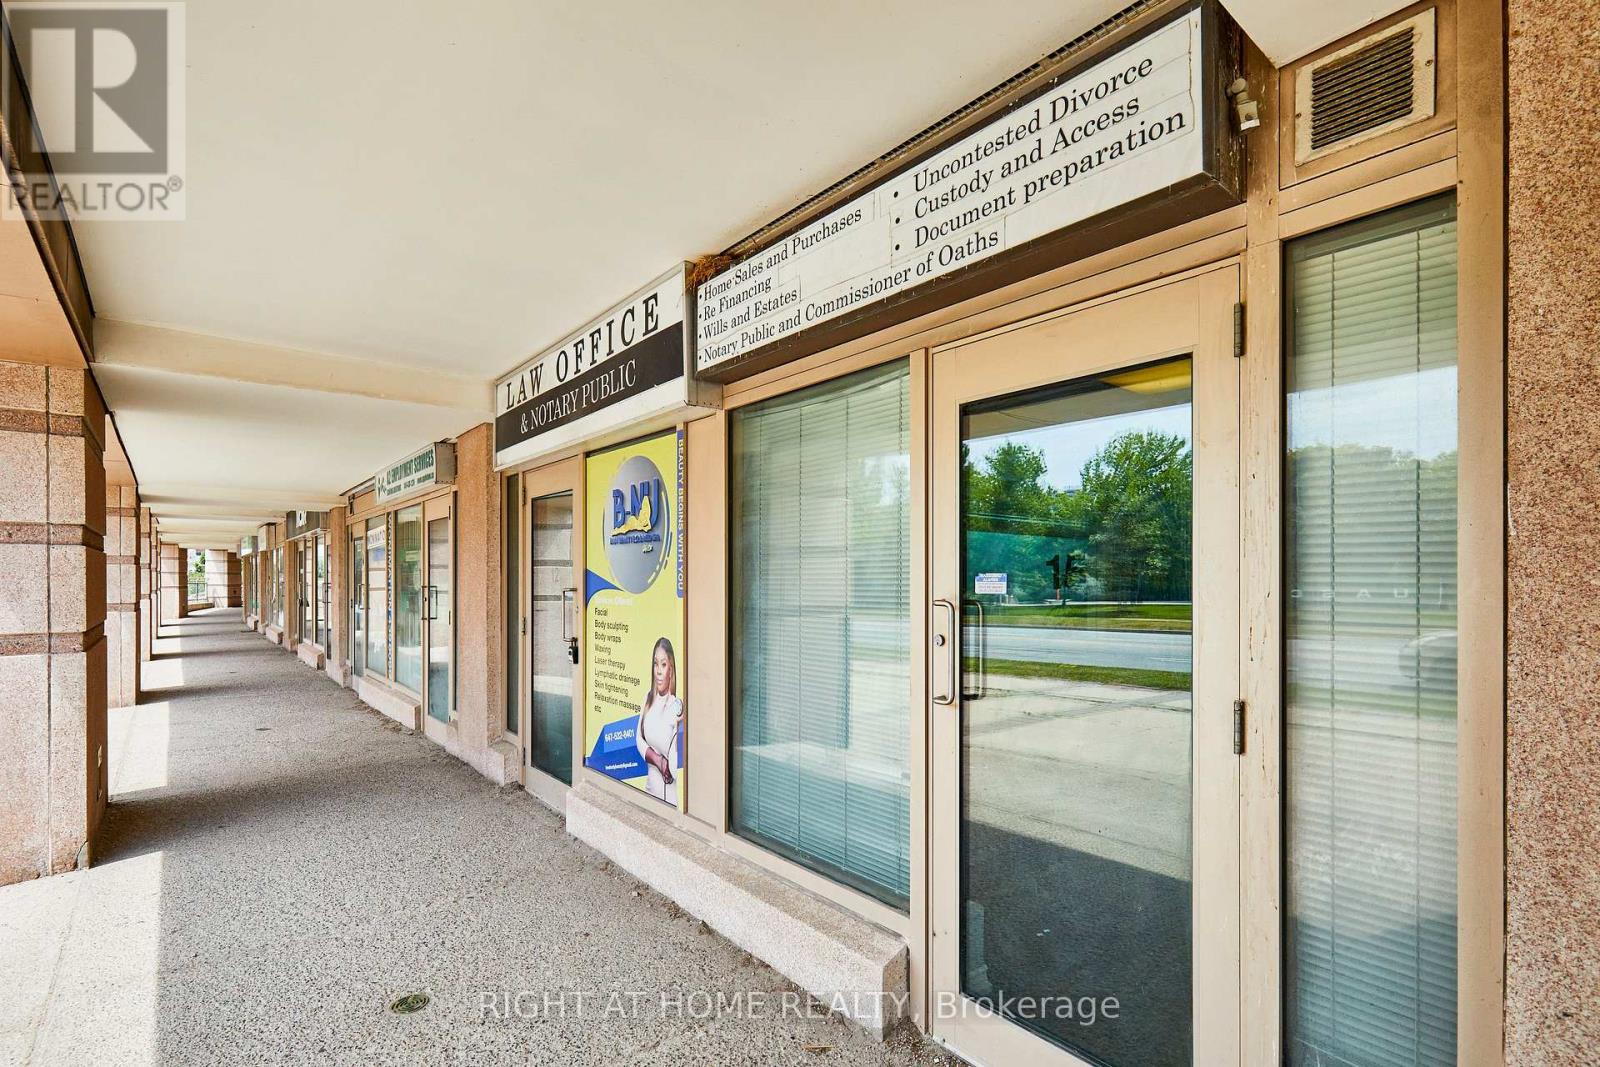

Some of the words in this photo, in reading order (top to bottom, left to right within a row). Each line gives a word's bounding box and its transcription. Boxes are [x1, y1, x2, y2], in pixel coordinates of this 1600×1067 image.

[913, 108, 1041, 193] Uncontested
[1049, 58, 1153, 125] Divorce
[914, 171, 994, 219] Custody
[1000, 143, 1044, 179] and
[1050, 97, 1140, 154] Access
[914, 187, 1016, 249] Document
[1023, 111, 1186, 205] preparation
[704, 279, 732, 301] Home
[734, 261, 763, 287] Sales
[766, 244, 788, 270] and
[791, 208, 862, 256] Purchases
[703, 340, 738, 363] Notary
[741, 321, 775, 349] Public
[778, 310, 801, 334] and
[805, 266, 911, 322] Commissioner
[916, 251, 934, 277] of
[938, 230, 999, 266] Oaths
[703, 305, 716, 322] Re
[719, 276, 772, 314] Financing
[703, 319, 728, 341] Wills
[731, 306, 750, 329] and
[754, 289, 798, 318] Estates
[506, 363, 544, 410] LAW
[556, 292, 659, 383] OFFICE
[520, 413, 528, 434] &
[530, 388, 580, 430] NOTARY
[582, 358, 637, 409] PUBLIC
[414, 449, 434, 473] SERVICES
[595, 607, 608, 616] Facial
[595, 620, 606, 630] Body
[607, 621, 628, 633] sculpting
[595, 632, 606, 642] Body
[607, 635, 621, 643] wraps
[595, 655, 606, 665] Laser
[607, 658, 625, 670] therapy
[595, 668, 617, 680] Lymphatic
[619, 673, 640, 686] drainage
[595, 680, 604, 688] Skin
[605, 683, 628, 697] tightening
[595, 692, 618, 705] Relaxation
[619, 700, 641, 713] massage
